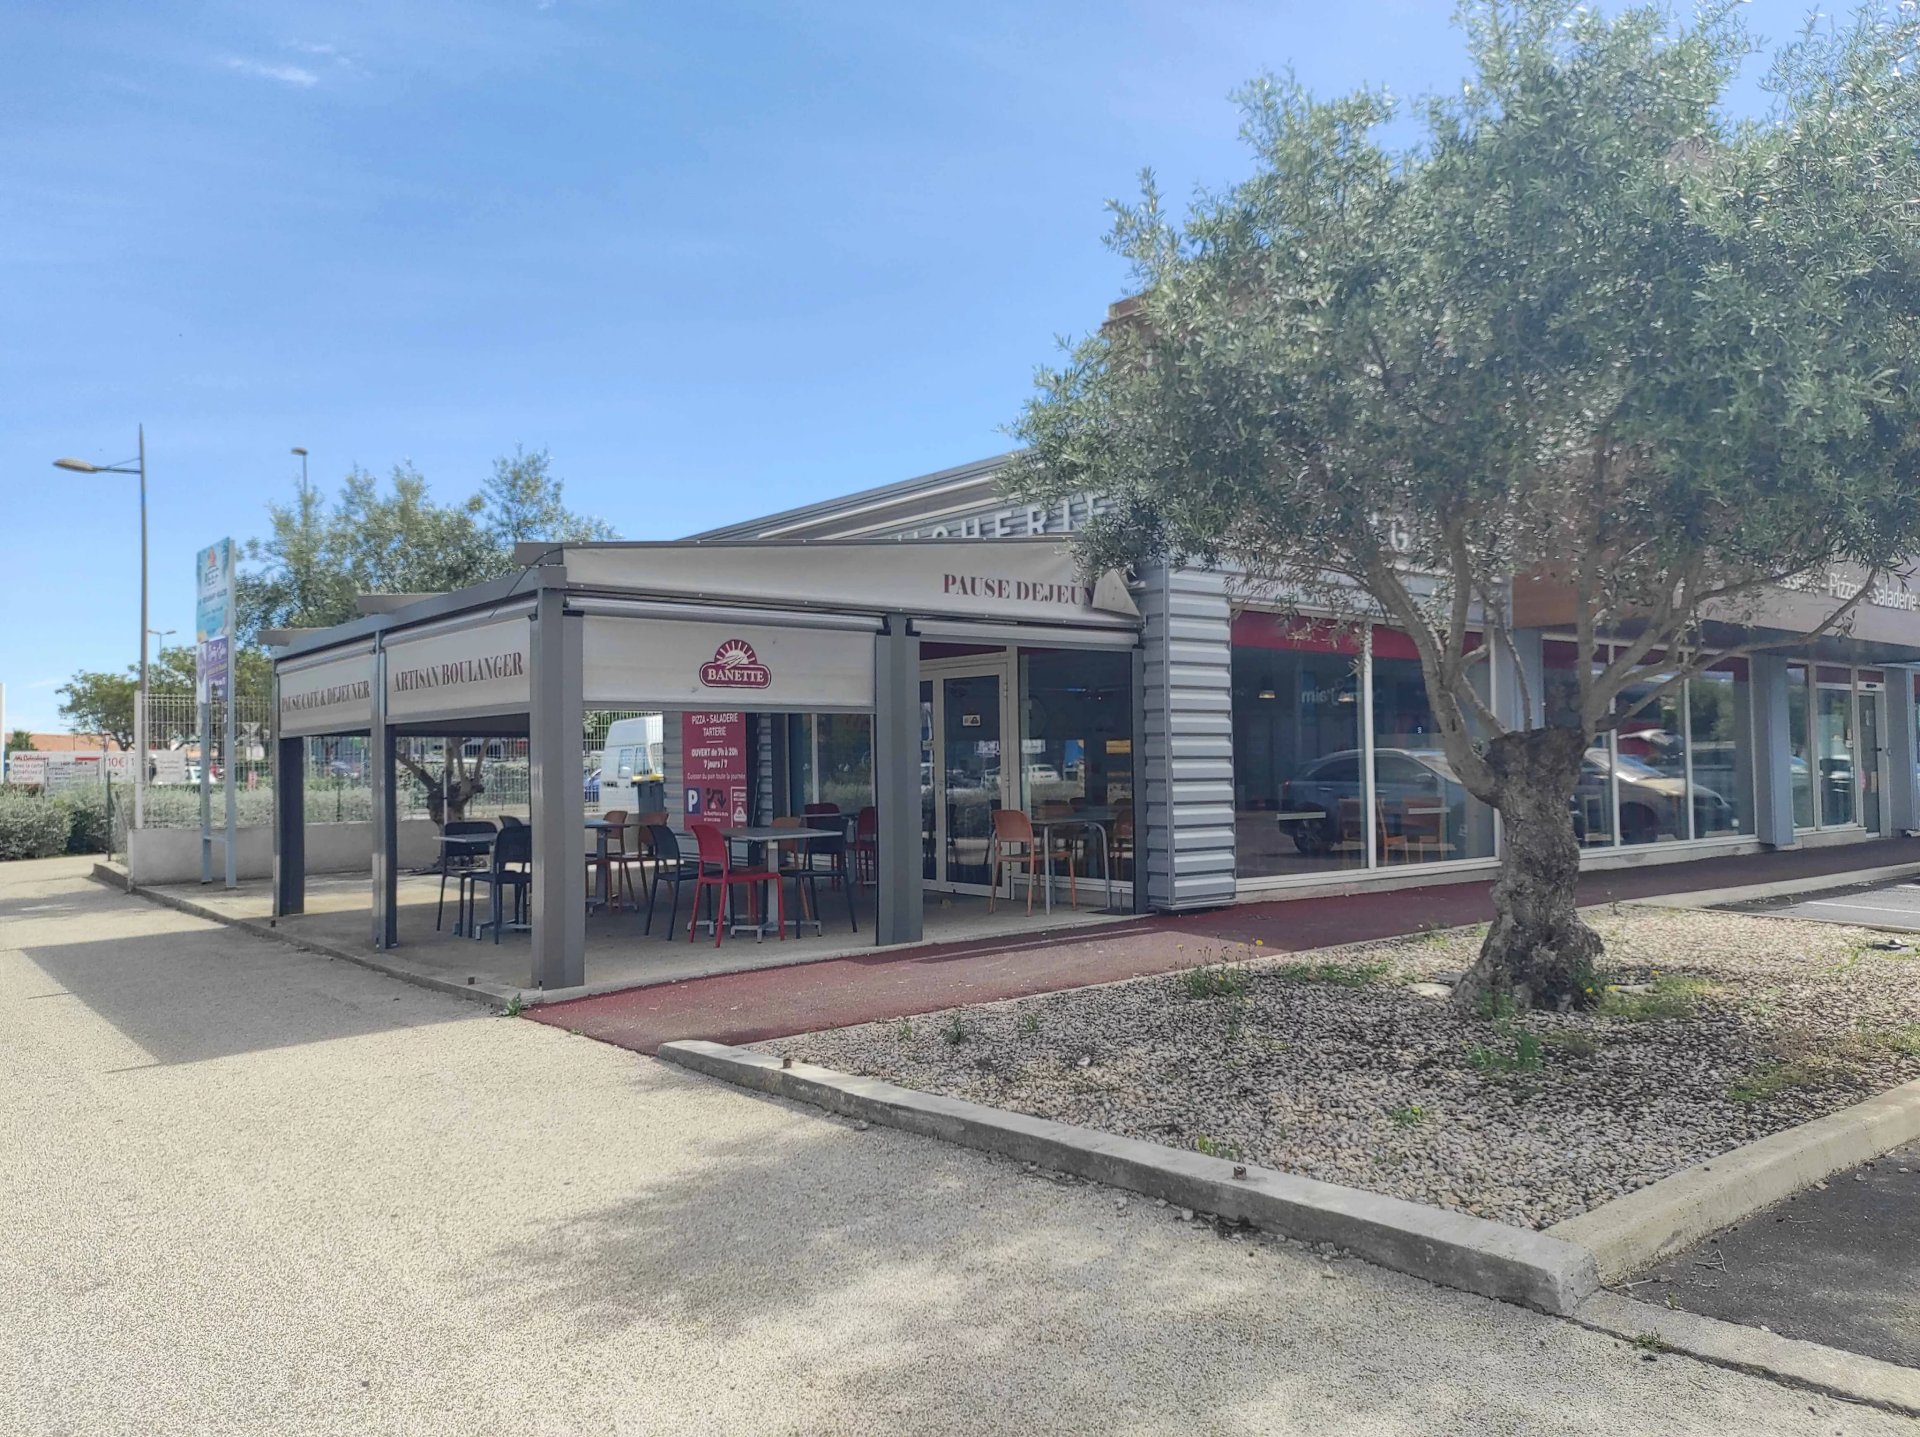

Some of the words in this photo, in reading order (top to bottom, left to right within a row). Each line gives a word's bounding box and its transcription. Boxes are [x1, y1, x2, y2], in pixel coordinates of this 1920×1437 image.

[943, 573, 1010, 600] PAUSE
[1872, 581, 1917, 611] Saladerie
[394, 665, 440, 692] ARTISAN
[440, 652, 523, 685] BOULANGER
[707, 668, 765, 682] BANETTE
[692, 714, 706, 725] PIZZA
[710, 712, 738, 724] SALADERIE
[703, 726, 727, 736] TARTERIE
[691, 747, 710, 757] OUVERT
[711, 748, 717, 757] de
[108, 756, 125, 769] 10€
[707, 759, 720, 770] jours
[688, 789, 698, 812] P
